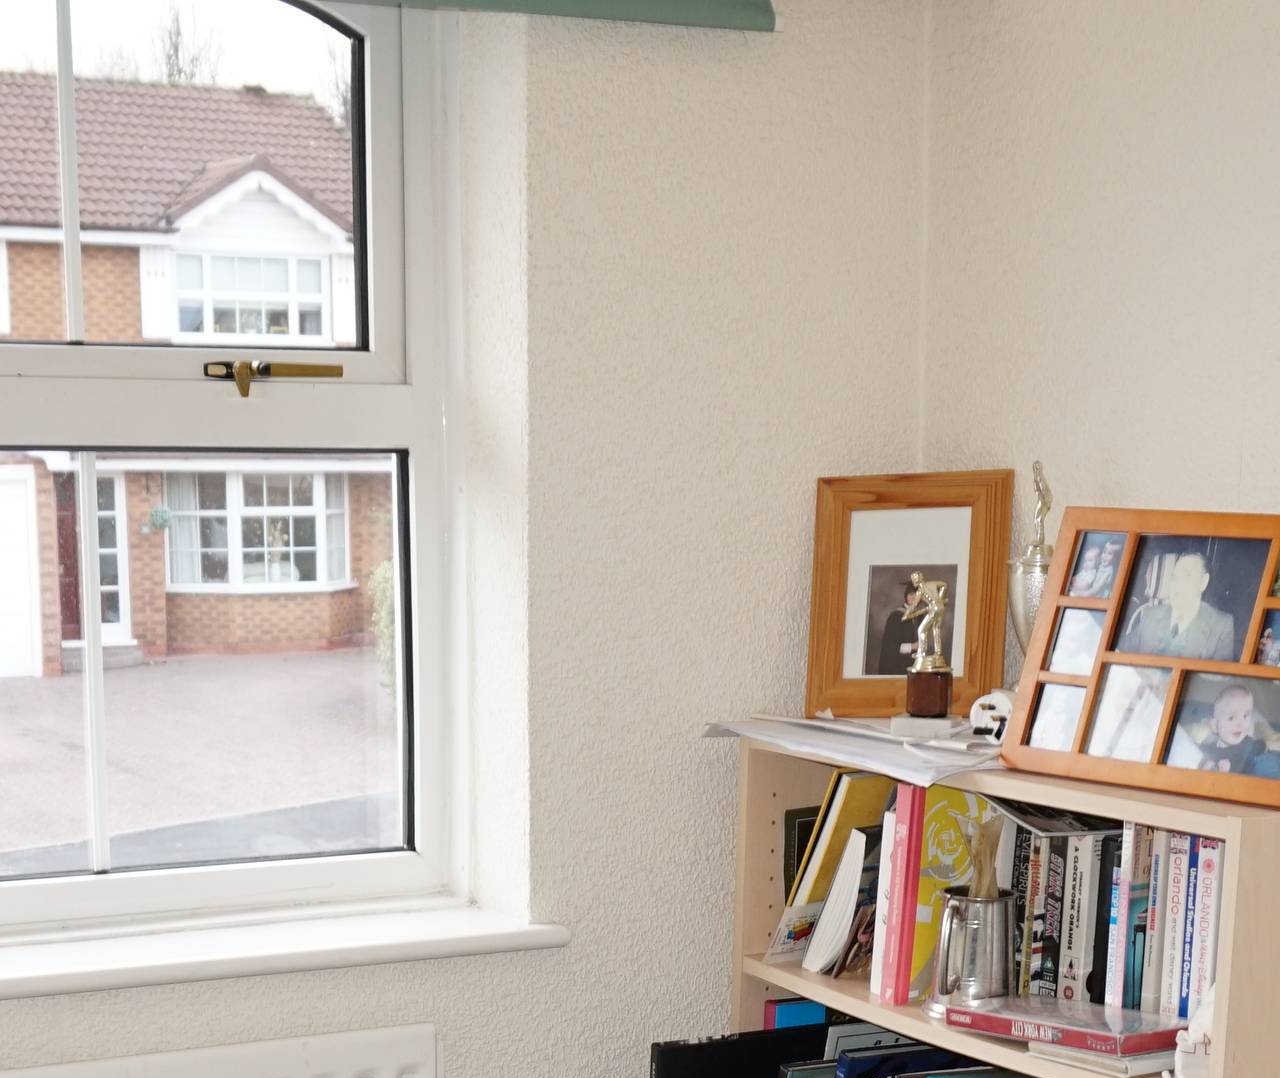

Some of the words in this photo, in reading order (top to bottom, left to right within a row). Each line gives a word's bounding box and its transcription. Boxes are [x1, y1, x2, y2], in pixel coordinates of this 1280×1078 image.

[1022, 834, 1032, 859] EVIL
[1017, 862, 1030, 905] SPIRITS
[1048, 852, 1064, 894] STAR
[1070, 856, 1079, 912] CLOCKWORK
[1171, 856, 1183, 916] orlando
[1187, 868, 1197, 909] Universal
[1045, 898, 1062, 943] TREK
[1184, 910, 1194, 942] Studios
[1198, 877, 1212, 938] ORLANDO
[1183, 944, 1192, 960] and
[1181, 963, 1191, 998] Orlando
[1010, 1020, 1024, 1036] CITY
[1024, 1023, 1039, 1038] YORK
[1038, 1025, 1052, 1041] NEW
